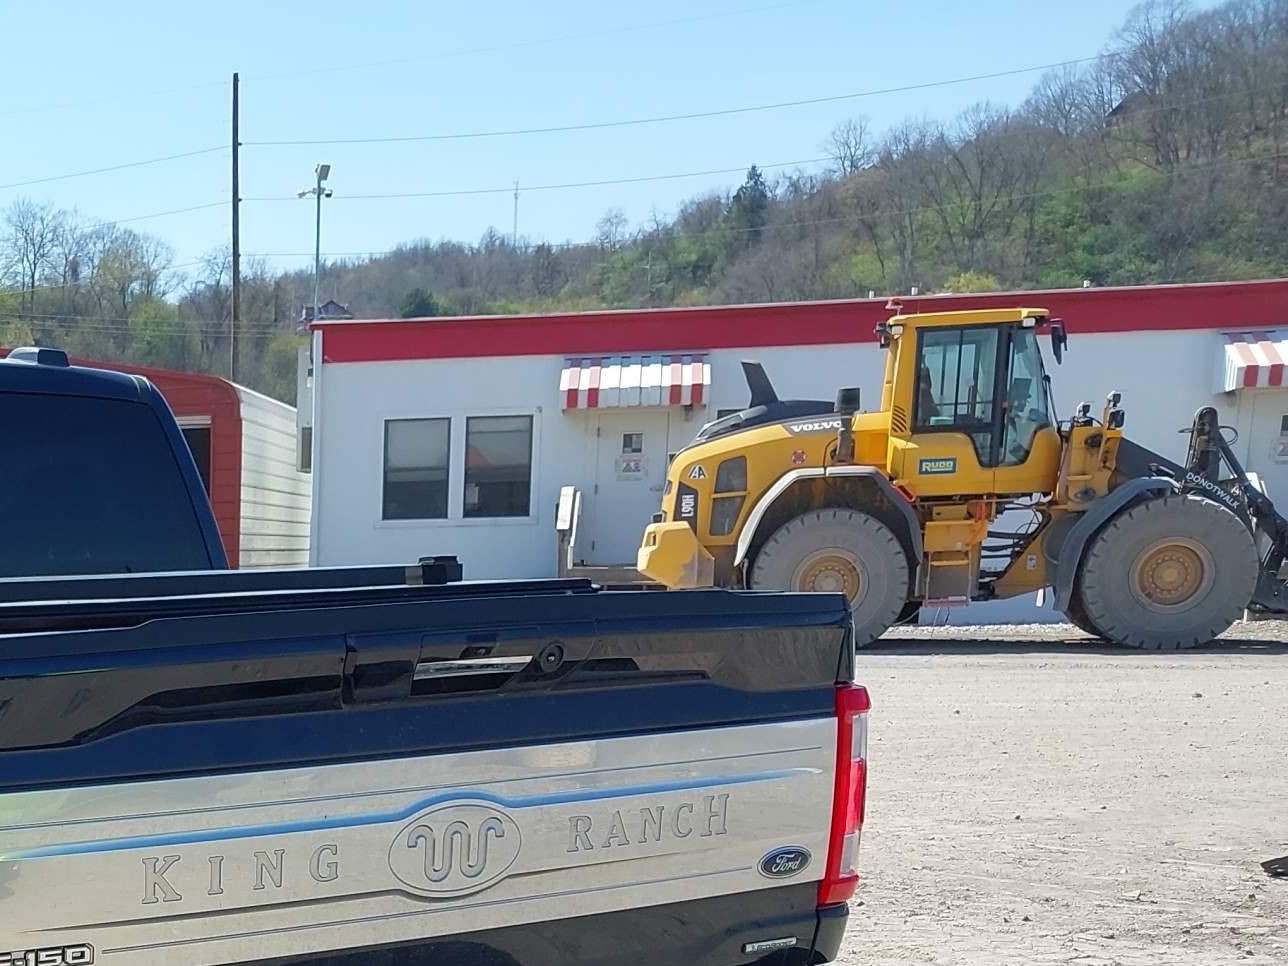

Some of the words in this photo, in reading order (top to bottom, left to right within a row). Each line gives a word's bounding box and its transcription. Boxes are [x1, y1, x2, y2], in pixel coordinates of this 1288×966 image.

[790, 420, 842, 433] VOLVO
[141, 844, 339, 905] KING
[566, 793, 730, 853] RANCH
